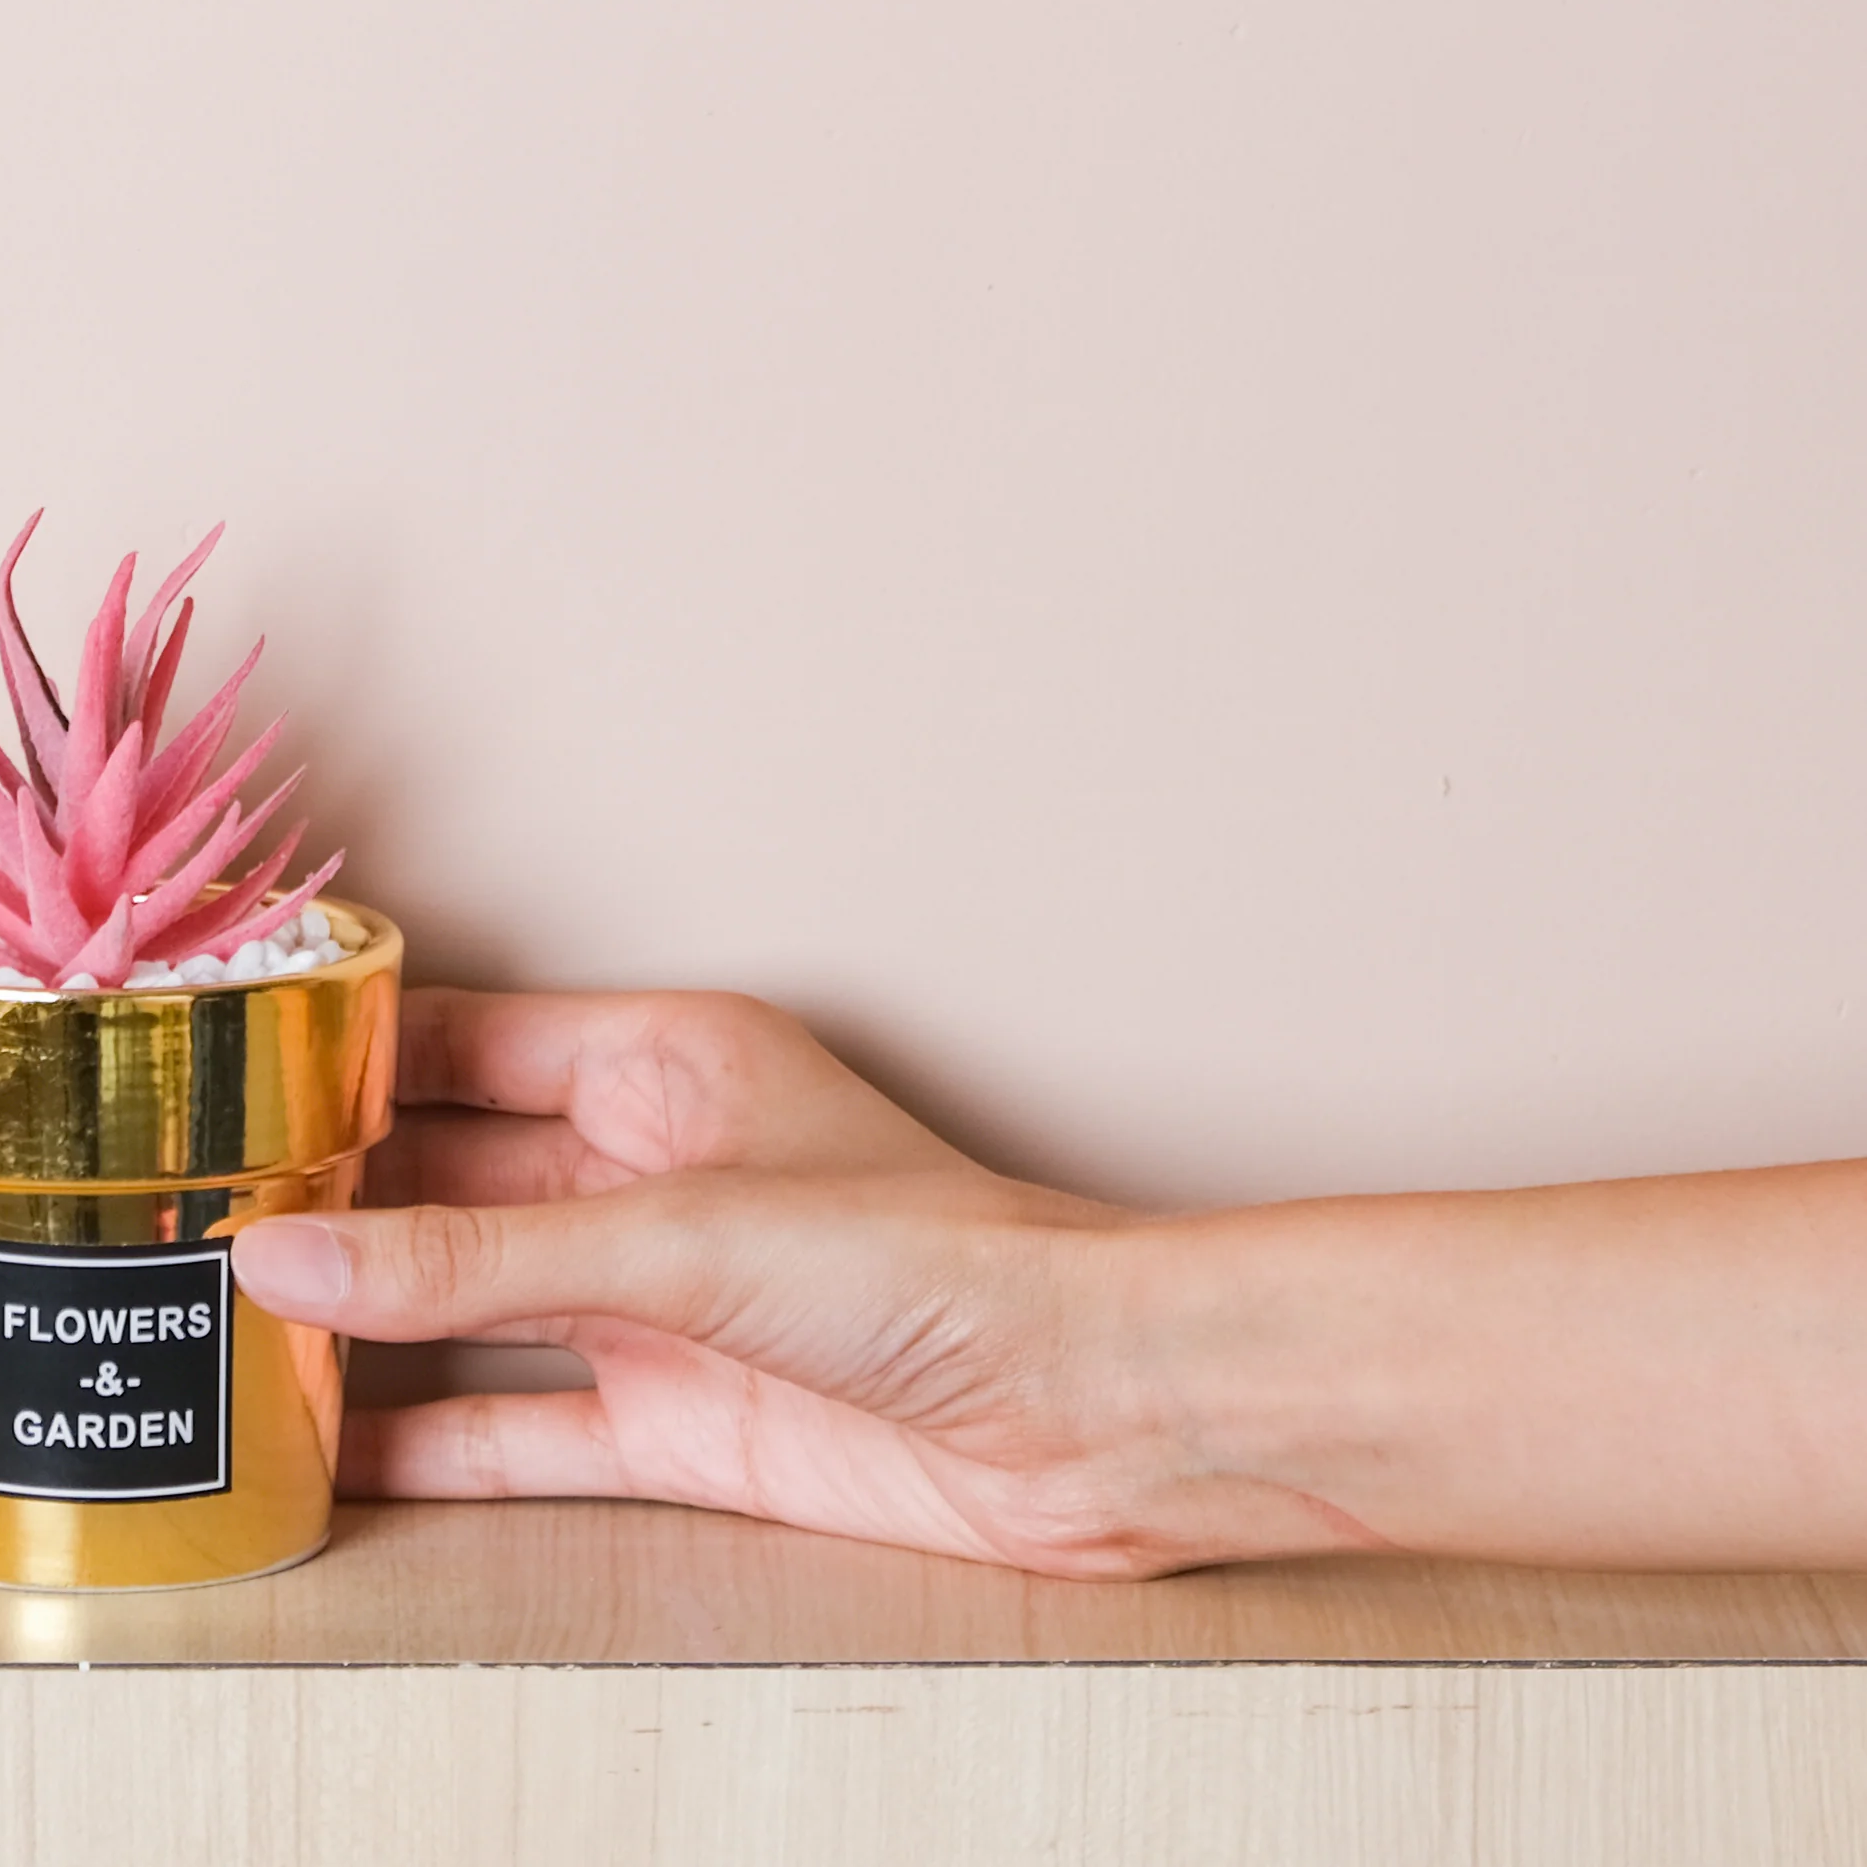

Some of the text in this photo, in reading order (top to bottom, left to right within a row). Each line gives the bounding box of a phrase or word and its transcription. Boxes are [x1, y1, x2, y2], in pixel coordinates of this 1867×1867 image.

[3, 1302, 212, 1344] FLOWERS
[79, 1360, 142, 1397] -&-
[13, 1409, 194, 1449] GARDEN
